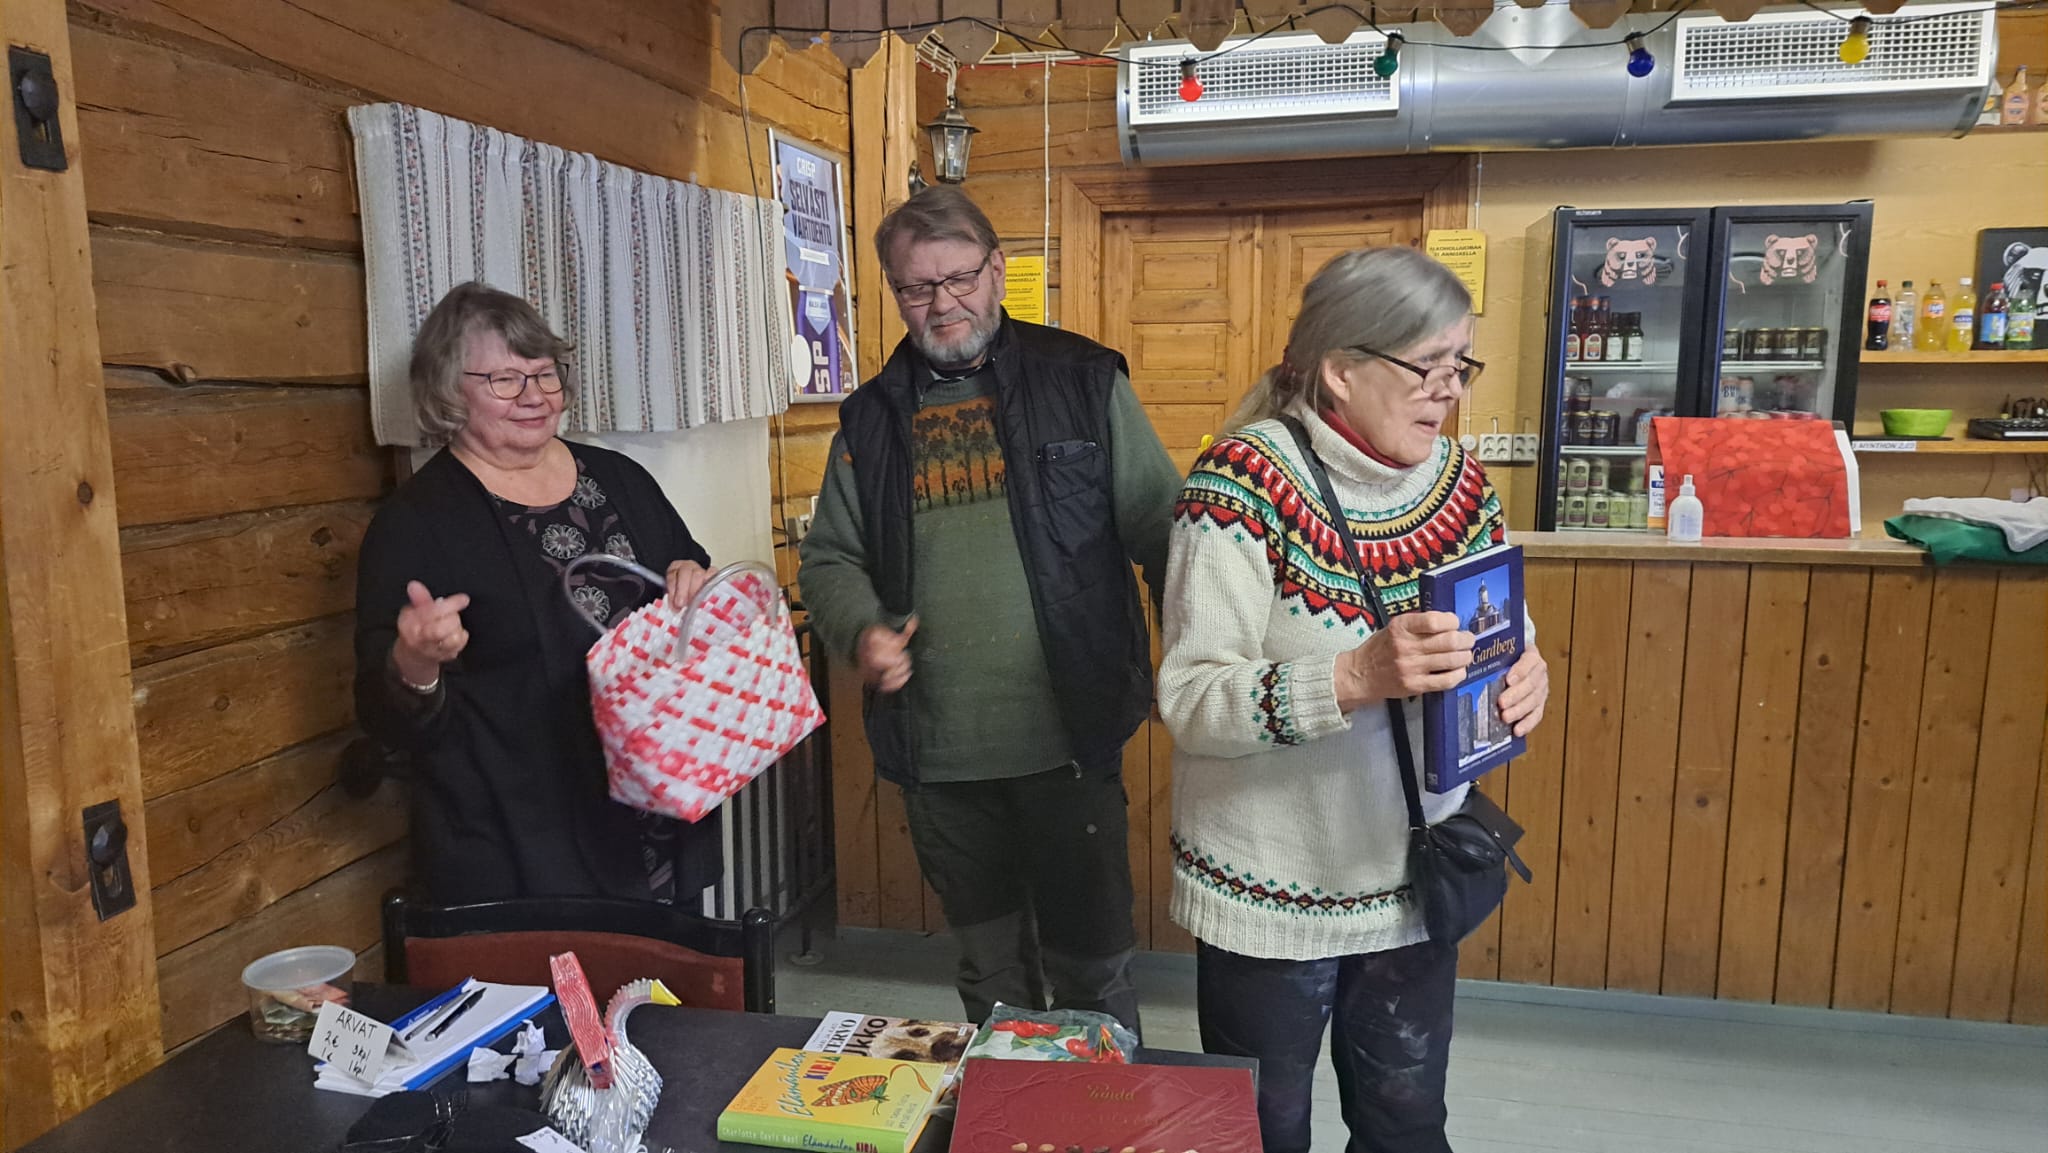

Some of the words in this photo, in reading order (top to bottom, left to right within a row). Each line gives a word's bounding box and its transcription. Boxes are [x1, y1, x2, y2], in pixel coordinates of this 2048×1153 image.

[789, 178, 830, 222] SELVÄSTI
[791, 212, 833, 247] VAIHTOEHTO
[1472, 636, 1516, 665] Gardberg
[335, 1010, 378, 1038] ARVAT
